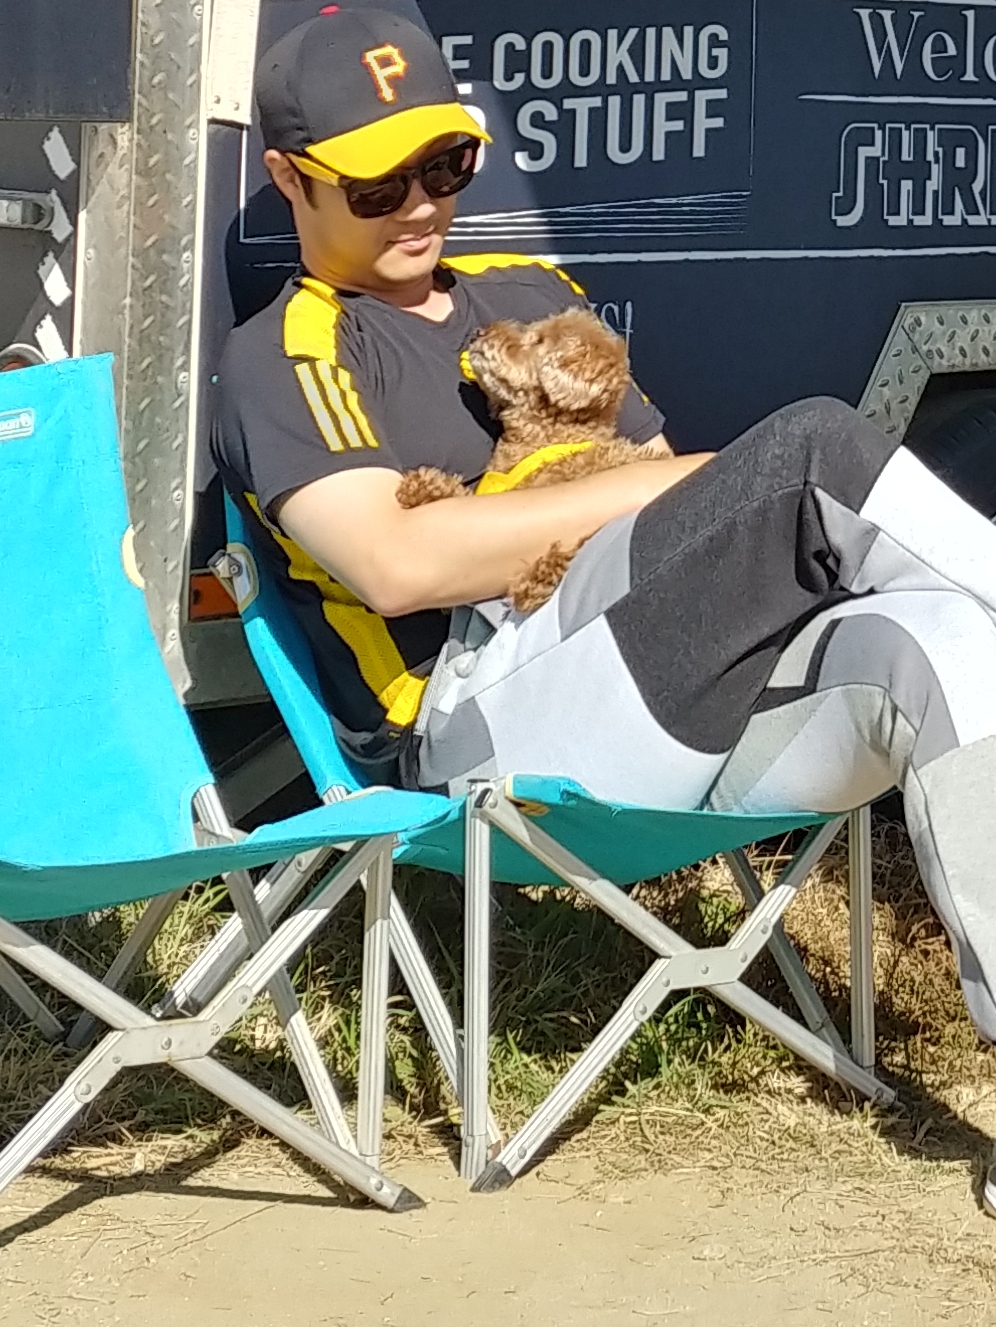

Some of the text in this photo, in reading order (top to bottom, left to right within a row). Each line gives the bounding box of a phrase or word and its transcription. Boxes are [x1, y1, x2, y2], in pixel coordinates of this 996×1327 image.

[364, 43, 407, 103] P
[492, 24, 729, 91] COOKING
[514, 88, 729, 173] STUFF
